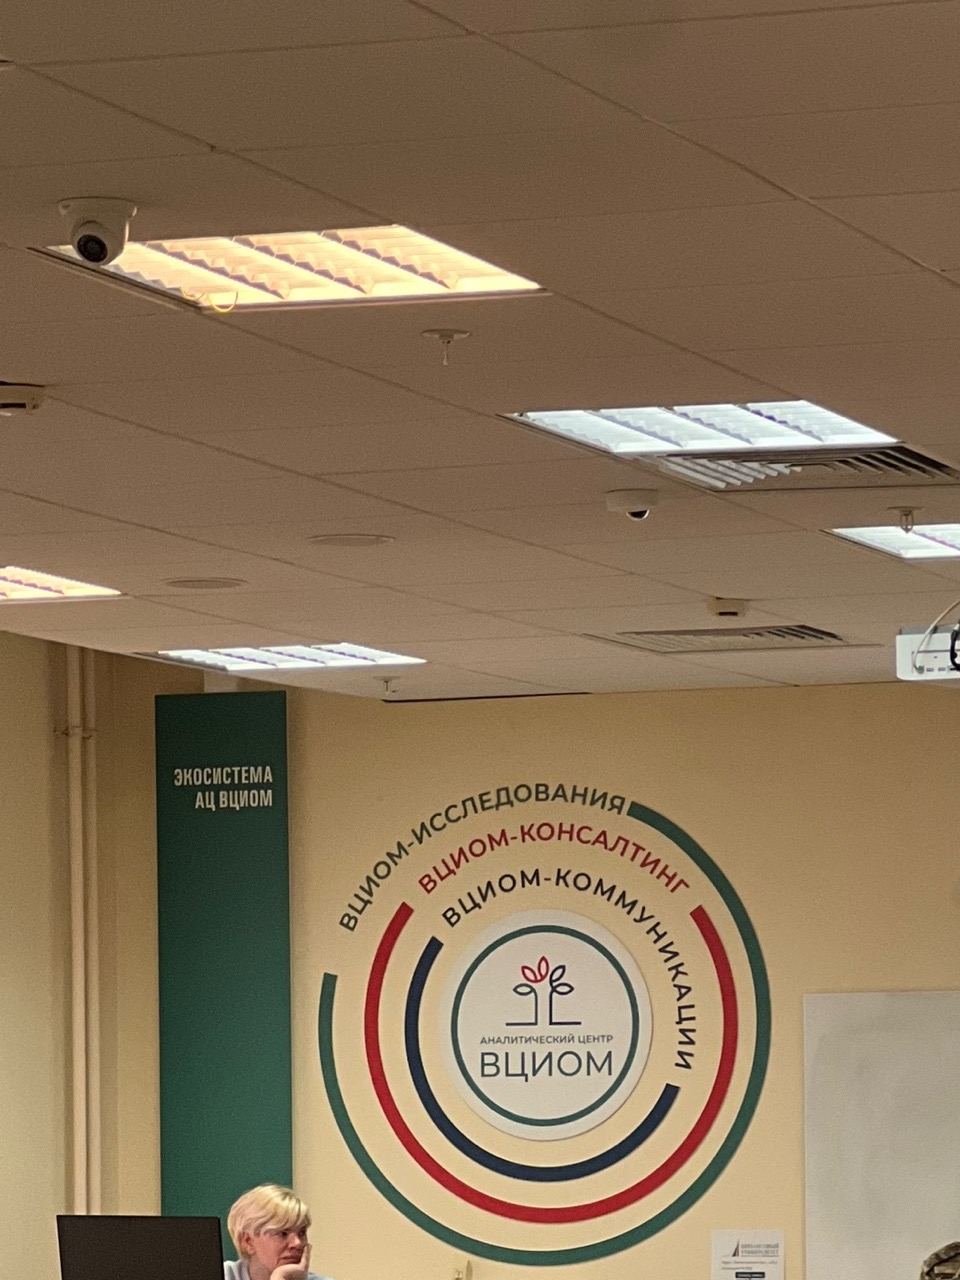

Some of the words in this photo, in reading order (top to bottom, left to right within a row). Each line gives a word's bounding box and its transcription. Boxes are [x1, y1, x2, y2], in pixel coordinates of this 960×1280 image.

[174, 766, 273, 786] ЭКОСИСТЕМА
[195, 791, 216, 812] АЦ
[219, 789, 273, 811] ВЦИОМ
[339, 783, 626, 932] ВЦИОМ-ИССЛЕДОВАНИЯ
[418, 822, 690, 895] ВЦИОМ-КОНСАЛТИНГ
[441, 868, 697, 1070] ВЦИОМ-КОММУНИКАЦИИ
[480, 1033, 575, 1045] АНАЛИТИЧЕСКИЙ
[578, 1034, 614, 1044] ЦЕНТР
[481, 1050, 613, 1082] ВЦИОМ
